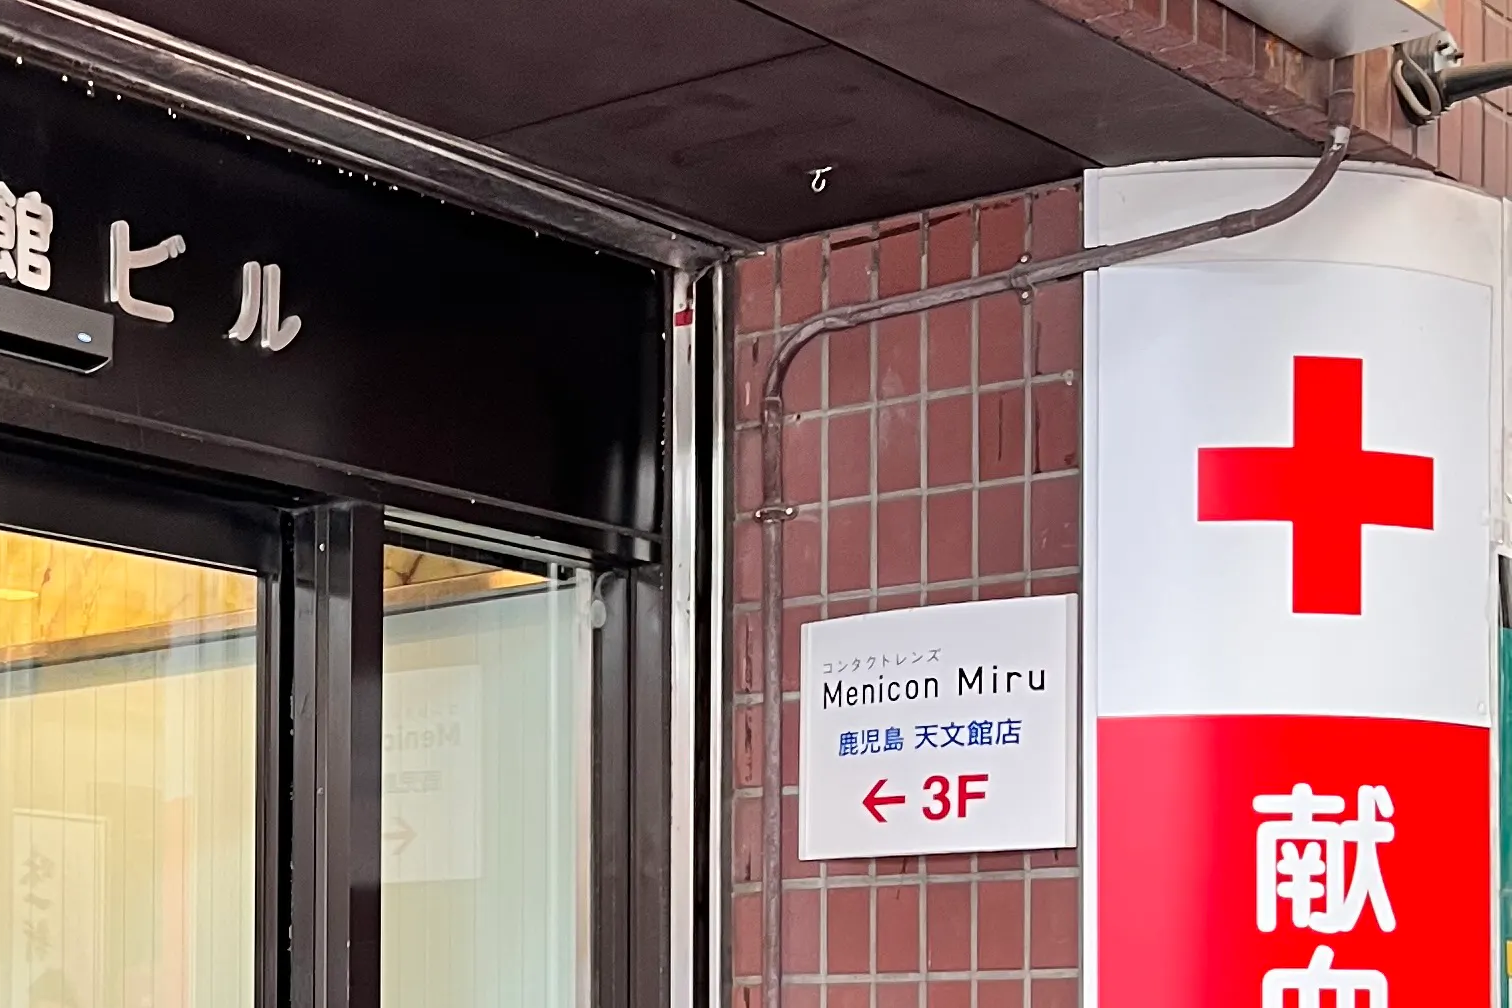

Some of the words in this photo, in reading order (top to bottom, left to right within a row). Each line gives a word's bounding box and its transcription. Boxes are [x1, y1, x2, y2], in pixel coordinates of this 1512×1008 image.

[823, 648, 942, 675] コンタクトレンズ
[823, 674, 939, 710] Menicon
[958, 665, 1046, 697] Miru
[838, 726, 905, 757] 鹿児島
[914, 717, 1023, 750] 天文館店
[922, 774, 990, 821] 3F
